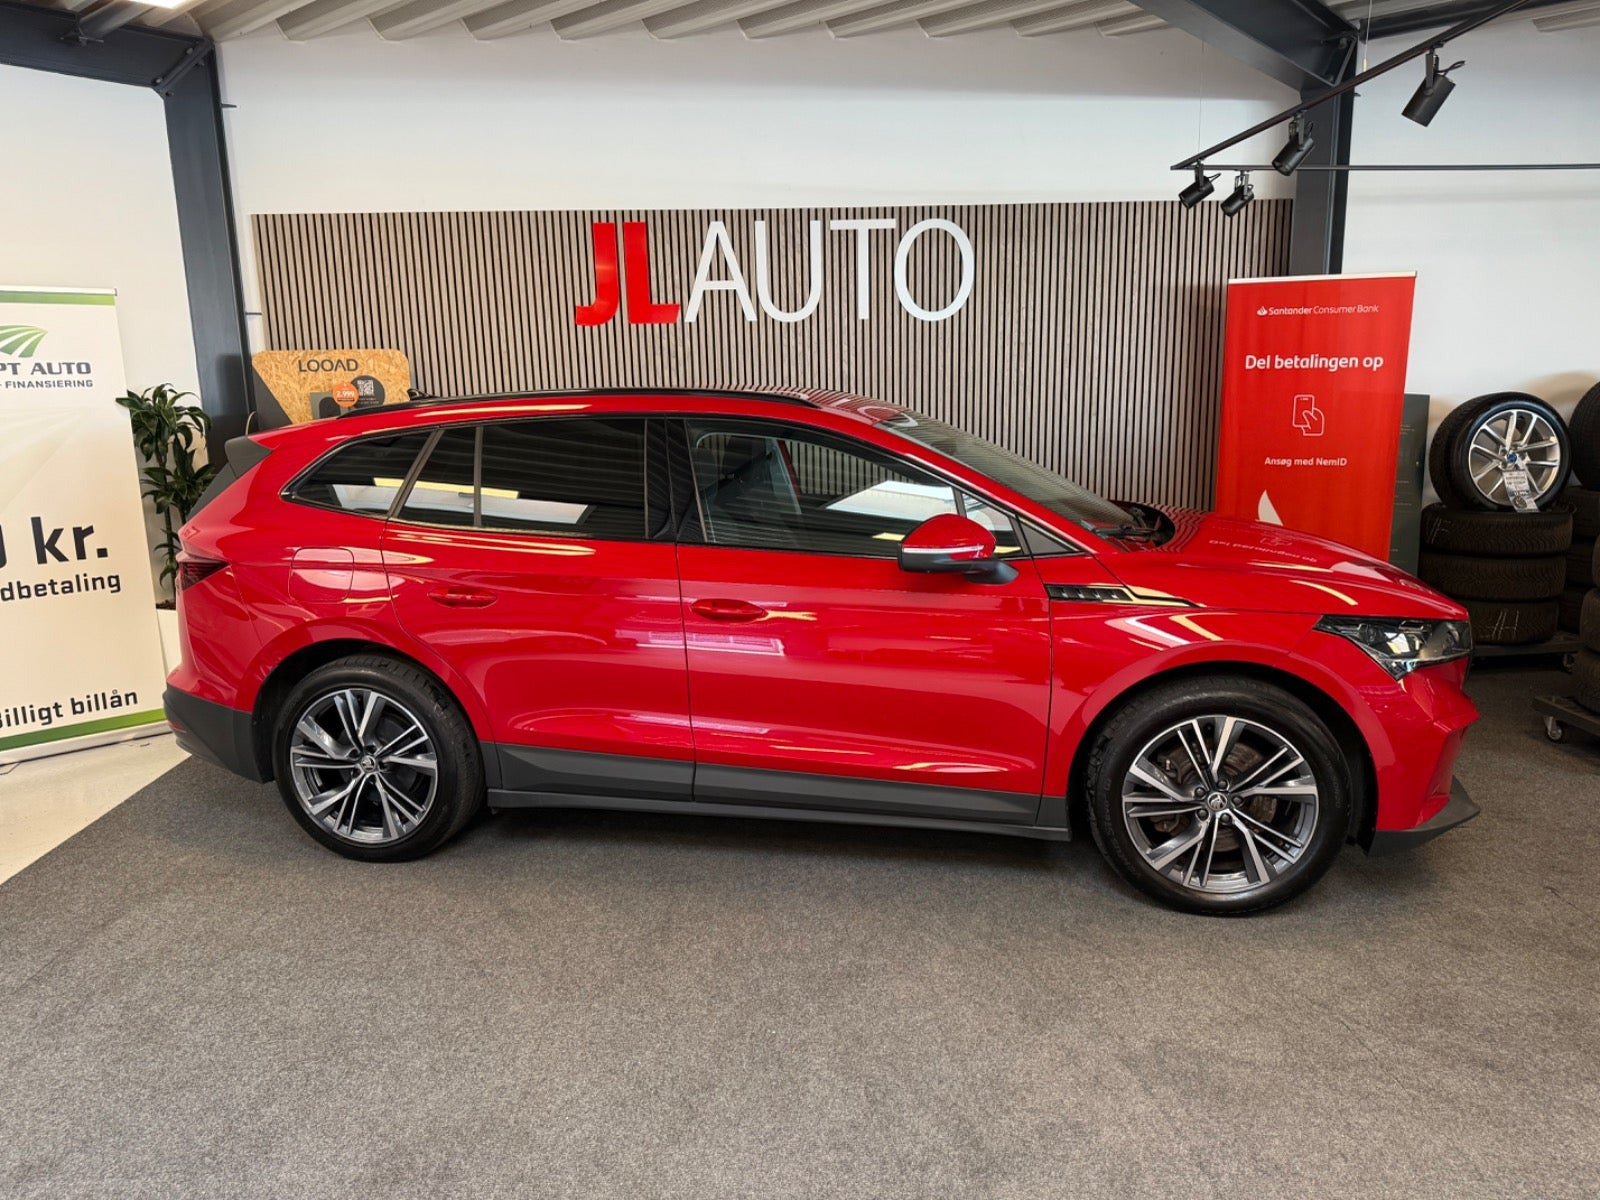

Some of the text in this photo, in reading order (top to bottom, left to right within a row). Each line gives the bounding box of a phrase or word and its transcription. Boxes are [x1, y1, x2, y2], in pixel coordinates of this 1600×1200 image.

[575, 218, 975, 326] JL AUTO
[1268, 304, 1379, 316] Santander Consumer Bank
[31, 361, 92, 376] AUTO
[1245, 353, 1384, 372] Del betalingen op
[5, 379, 94, 389] FINANSIERING
[1264, 456, 1348, 468] Ansøg med NemID
[31, 516, 109, 565] kr.
[0, 688, 139, 729] illigt billån
